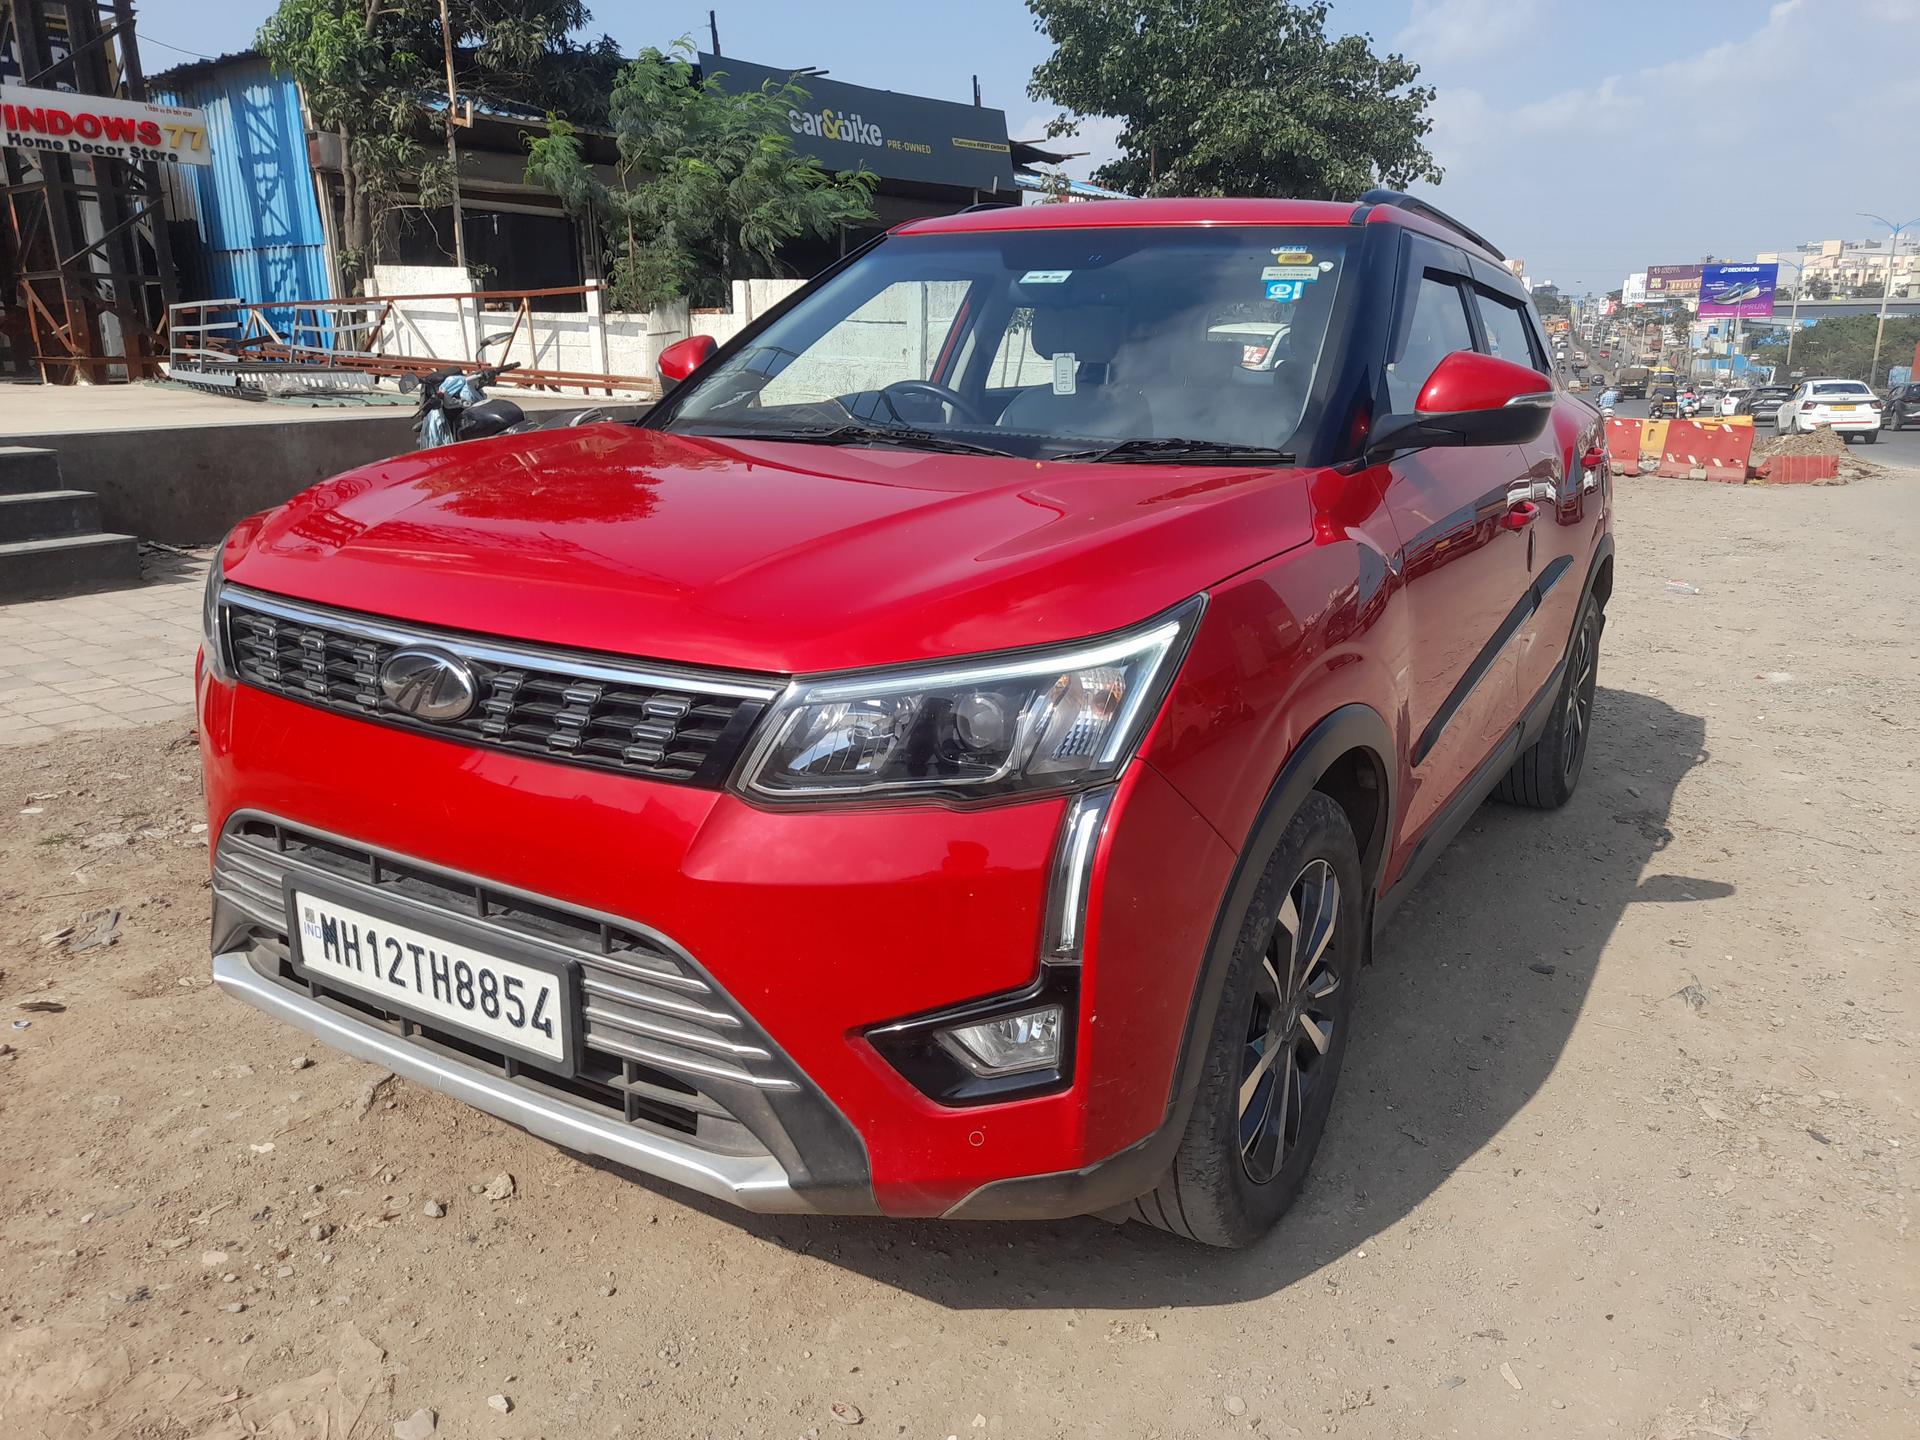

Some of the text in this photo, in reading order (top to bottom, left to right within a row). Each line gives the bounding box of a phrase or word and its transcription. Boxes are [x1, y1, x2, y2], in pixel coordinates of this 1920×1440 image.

[0, 103, 205, 151] INDOWS 77
[7, 132, 178, 163] Home Decor Store
[886, 138, 932, 155] PRE-OWNED
[304, 922, 322, 939] IND
[320, 912, 553, 1039] MH12TH8854
